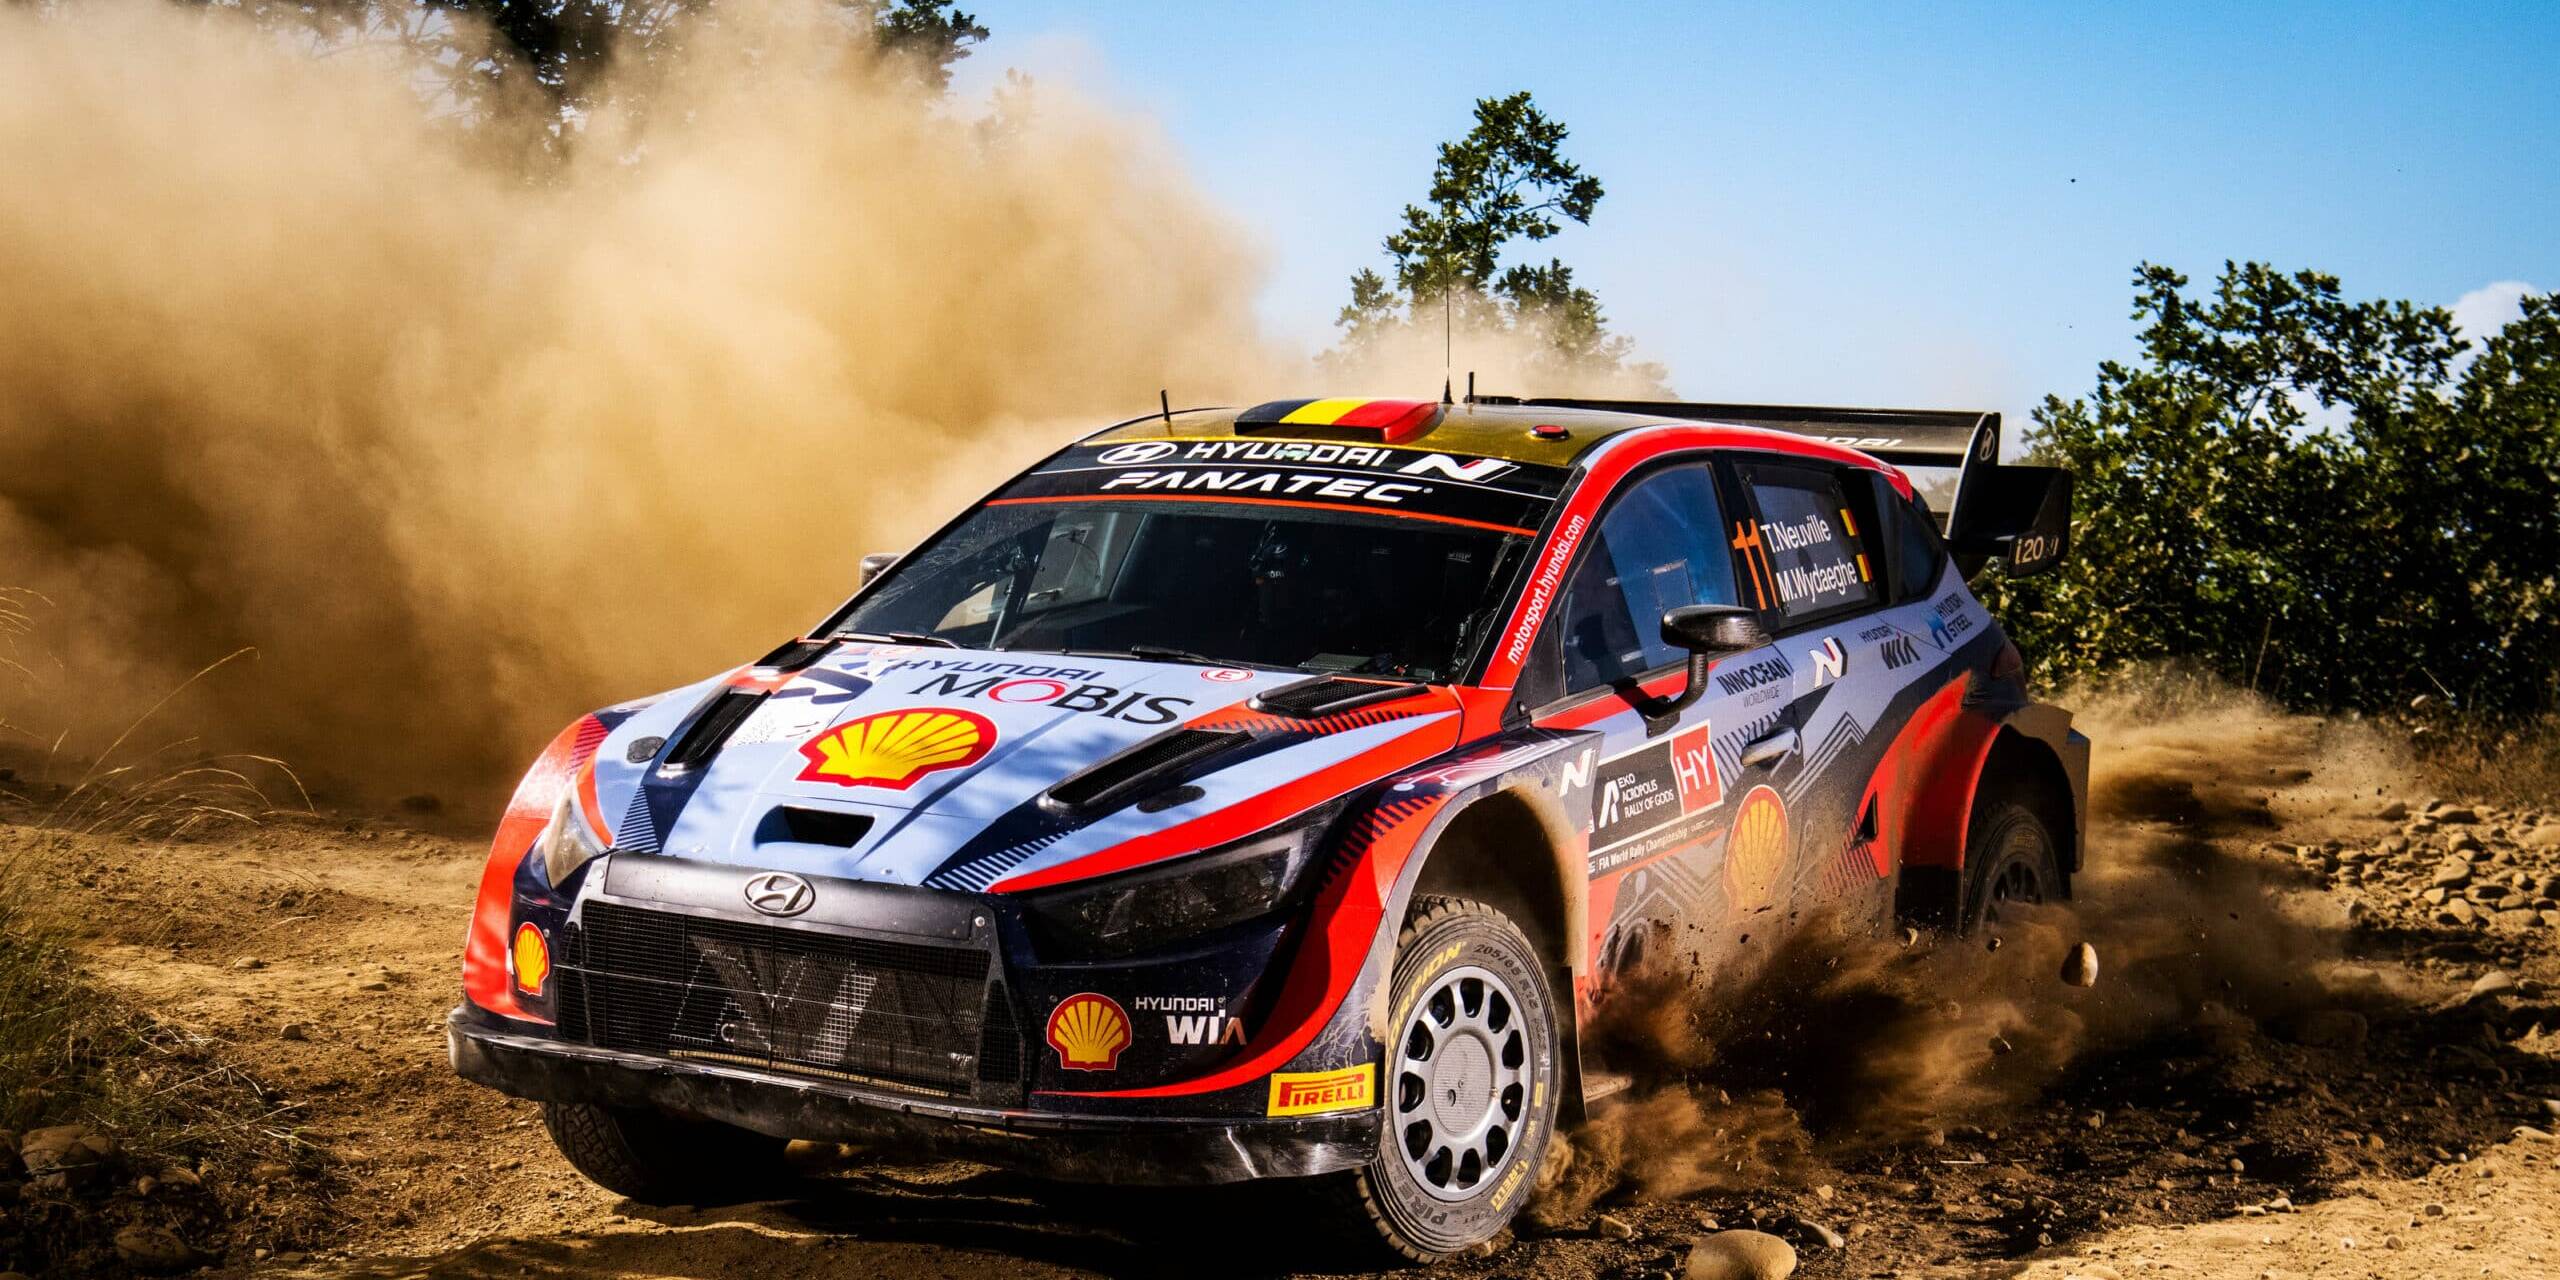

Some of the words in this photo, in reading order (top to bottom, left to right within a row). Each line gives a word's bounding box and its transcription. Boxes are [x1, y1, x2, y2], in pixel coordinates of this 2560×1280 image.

[1184, 441, 1392, 466] HYUNDAI
[1101, 471, 1431, 502] FANATEC
[1760, 515, 1831, 553] T.Neuville
[1732, 517, 1779, 611] 11
[1507, 514, 1586, 664] motorsport.hyundai.com
[1776, 558, 1857, 603] M.Wydaeghe
[896, 659, 1106, 681] HYUNDAI
[1716, 658, 1791, 696] INNOCEAN
[908, 673, 1194, 724] MOBIS
[1743, 685, 1780, 707] WORLDWIDE
[1618, 773, 1635, 788] EKO
[1675, 744, 1711, 794] HY
[1622, 779, 1658, 803] ACROPOLIS
[1624, 801, 1643, 818] RALLY
[1644, 797, 1656, 811] OF
[1655, 789, 1675, 806] GODS
[1610, 848, 1629, 867] World
[1135, 997, 1214, 1011] HYUNDAI
[1278, 1073, 1365, 1107] PIRELLI
[1490, 1159, 1529, 1212] PIRELLI
